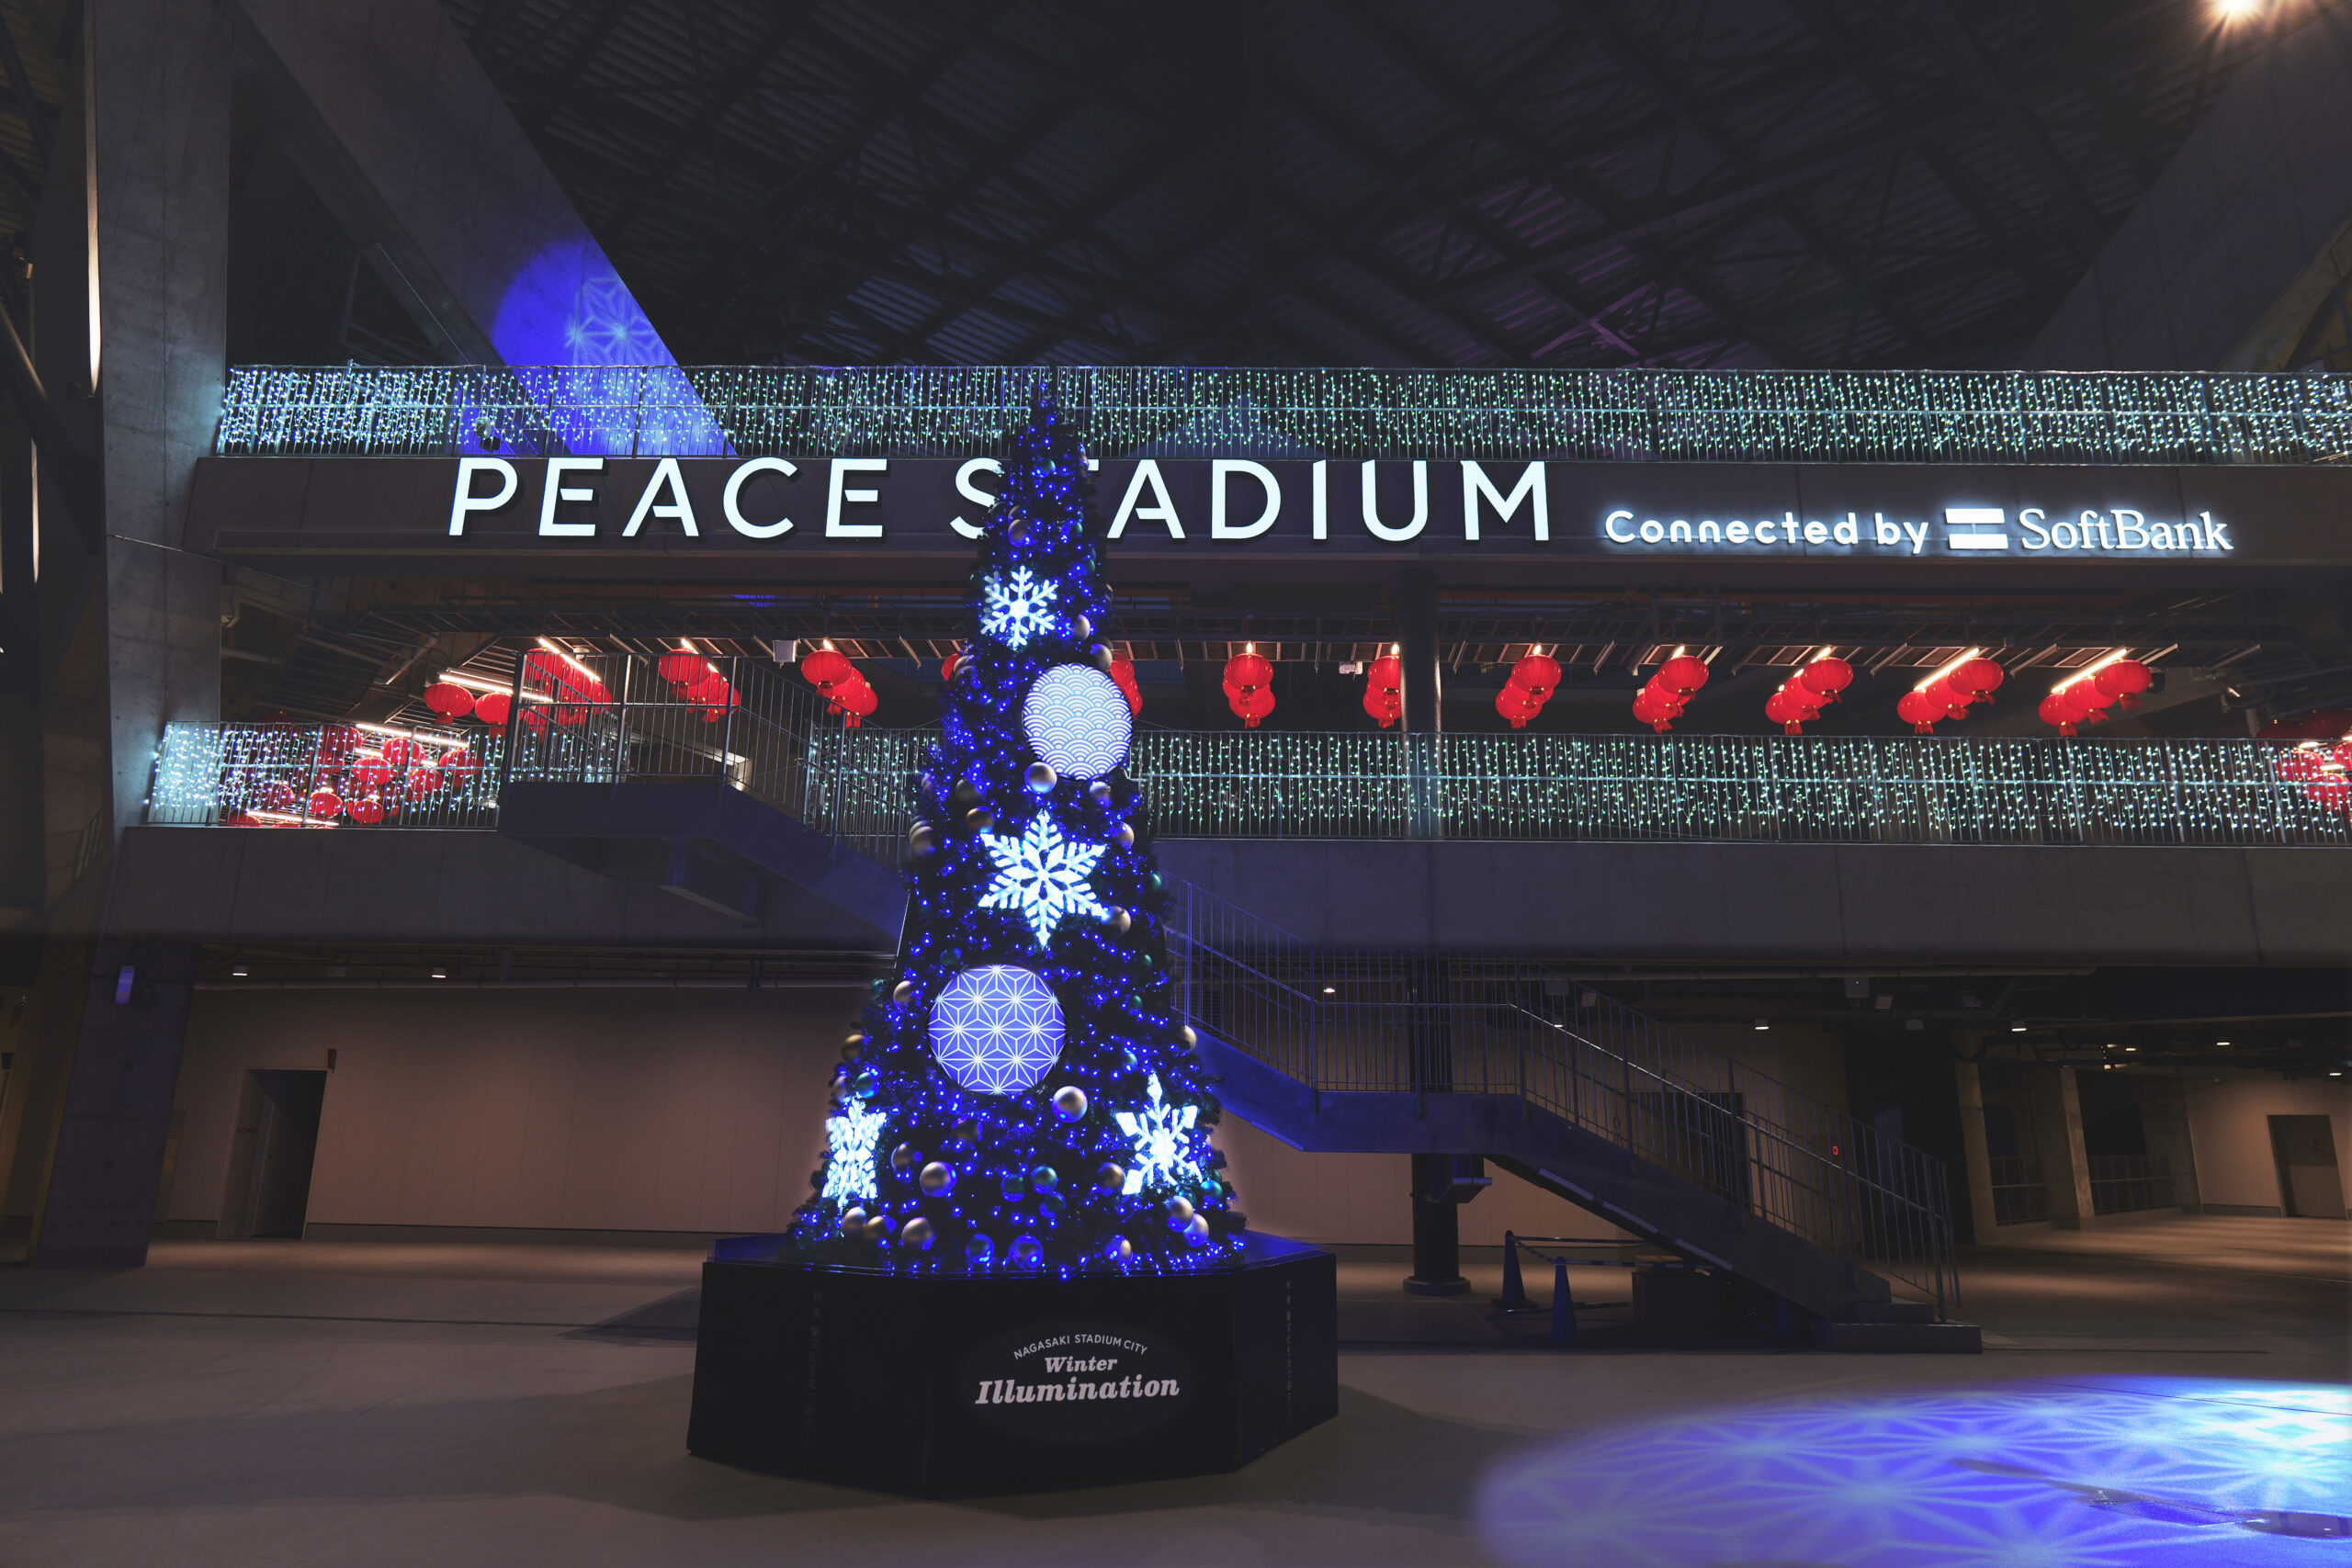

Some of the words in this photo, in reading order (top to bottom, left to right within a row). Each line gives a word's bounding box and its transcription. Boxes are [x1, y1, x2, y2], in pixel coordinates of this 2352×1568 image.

[448, 457, 888, 540] PEACE
[949, 457, 1550, 542] SADIUM
[1604, 510, 1860, 545] Connected
[1874, 512, 1930, 555] by
[2018, 507, 2235, 551] SoftBank
[1013, 1335, 1070, 1359] NAGASAKI
[1074, 1333, 1122, 1348] STADIUM
[1124, 1339, 1148, 1355] CITY
[1044, 1355, 1118, 1373] Winter
[974, 1373, 1181, 1404] Illumination
